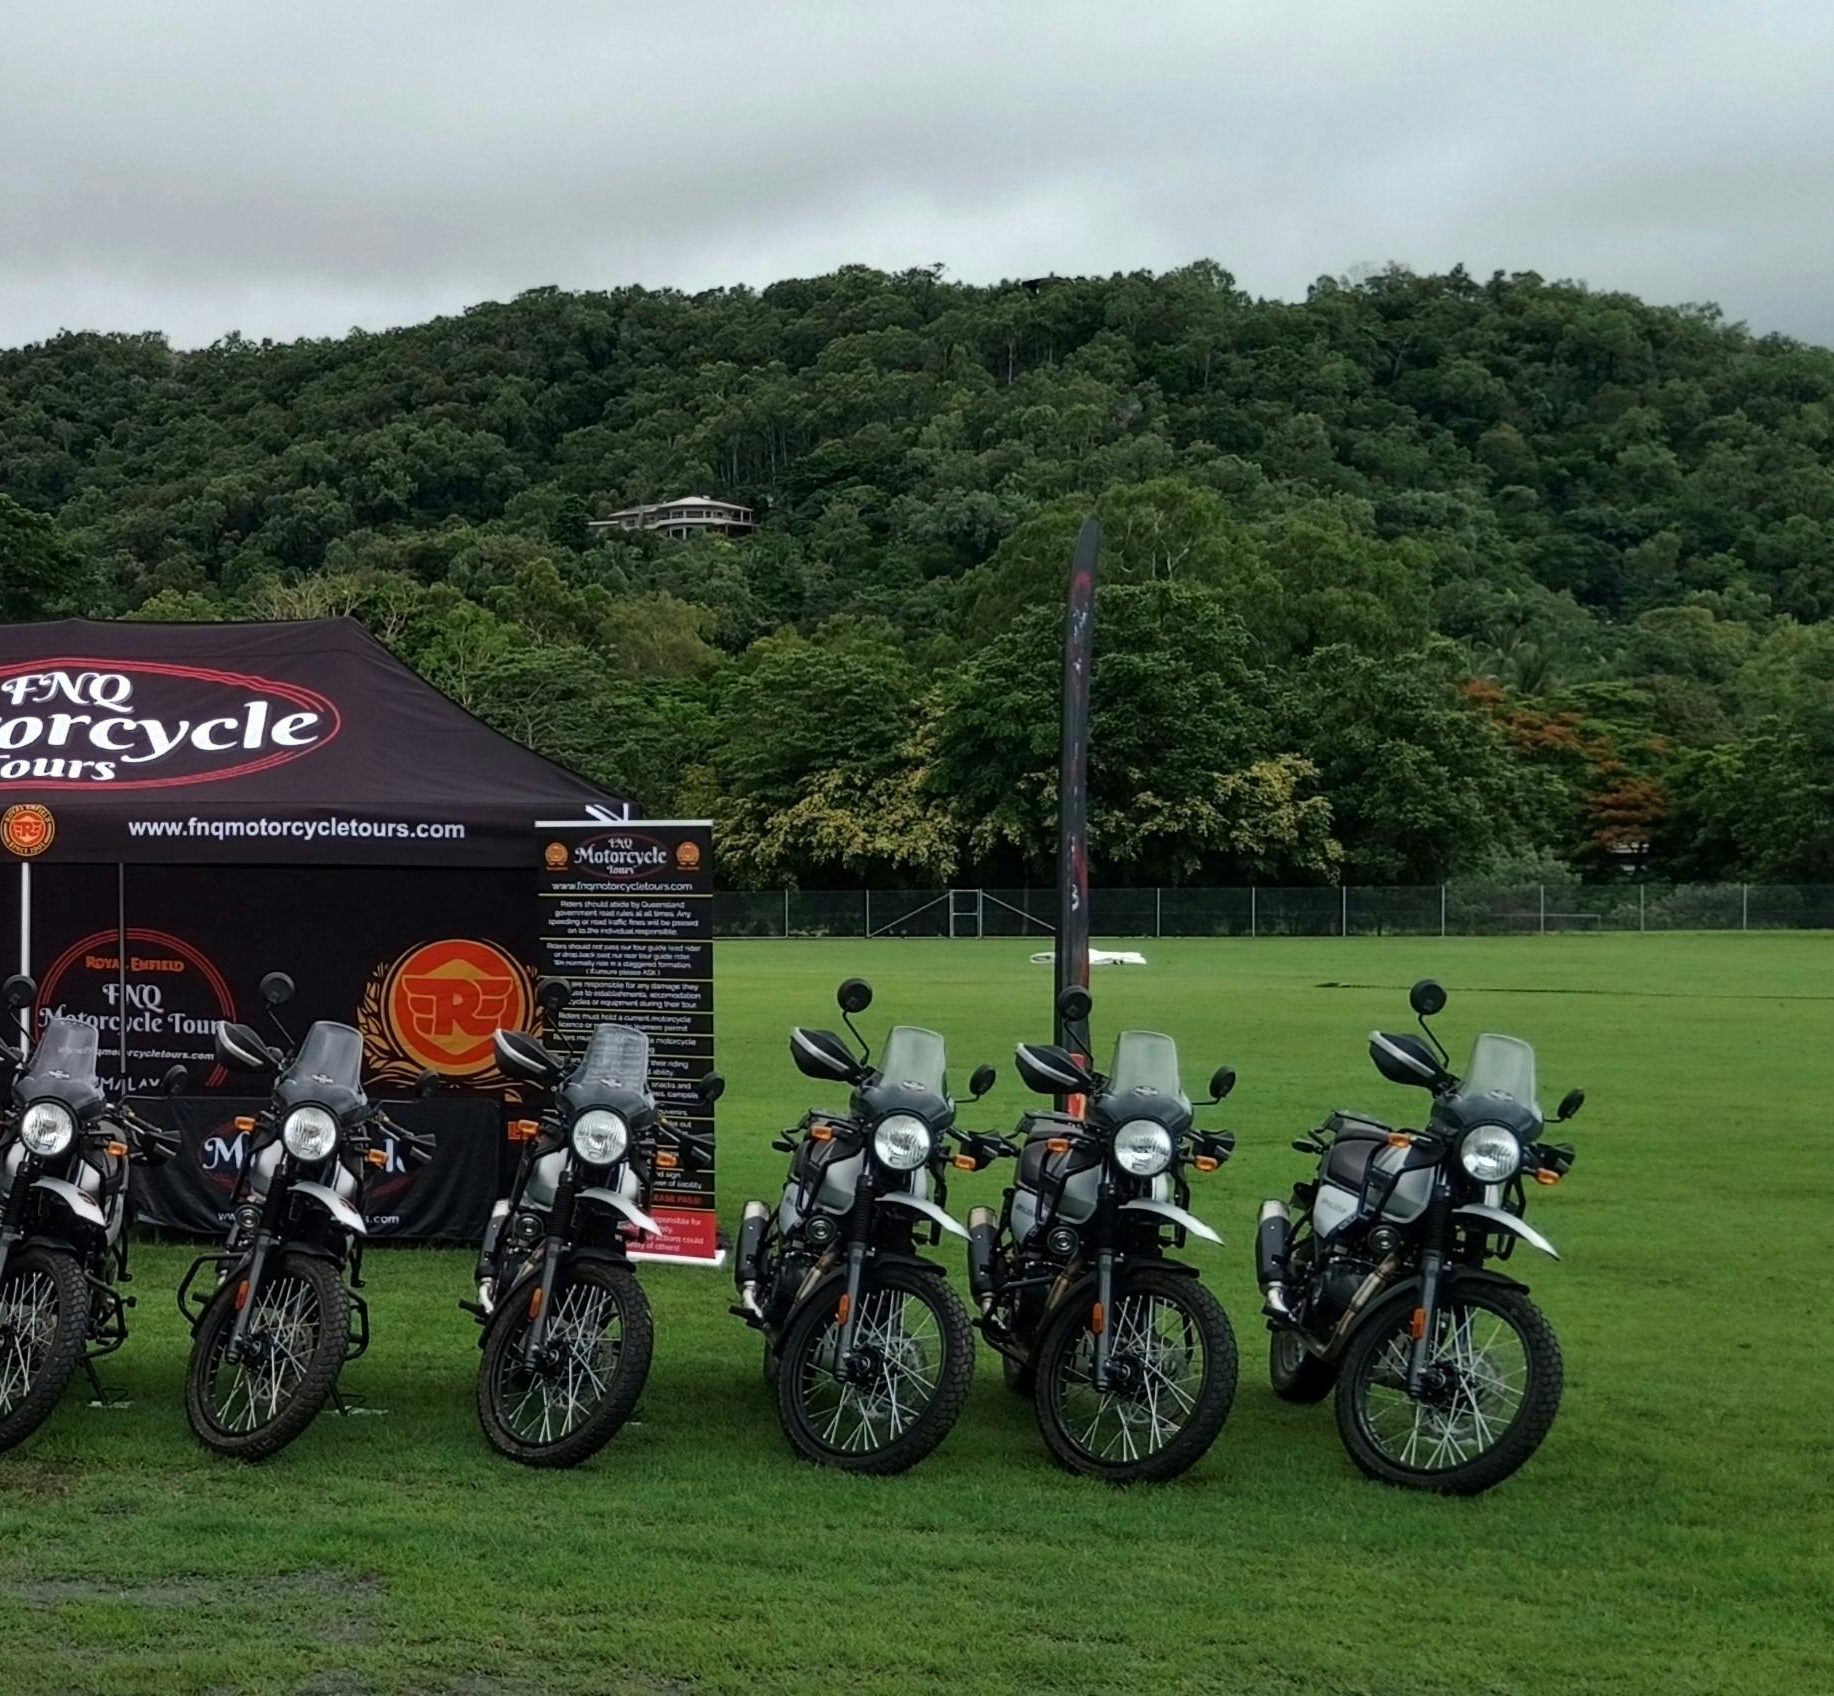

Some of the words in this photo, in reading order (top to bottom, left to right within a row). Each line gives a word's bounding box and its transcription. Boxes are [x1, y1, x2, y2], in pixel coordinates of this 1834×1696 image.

[1, 671, 134, 714] FNQ
[128, 817, 465, 839] www.fnqmotorcycletours.com
[608, 838, 633, 848] FNQ
[574, 844, 667, 865] Motorcycle
[607, 866, 638, 875] Tours
[551, 881, 692, 892] www.fnqmotorcycletours.com
[677, 911, 691, 919] Any
[548, 919, 580, 927] speeding
[660, 920, 670, 928] be
[672, 920, 699, 928] passed
[85, 955, 129, 970] ROYA
[131, 956, 185, 972] ENFIELD
[102, 983, 165, 1013] FNQ
[651, 1014, 692, 1022] motorcycle
[167, 1012, 222, 1036] Tour
[656, 1038, 697, 1047] motorcycle
[683, 1237, 704, 1245] could
